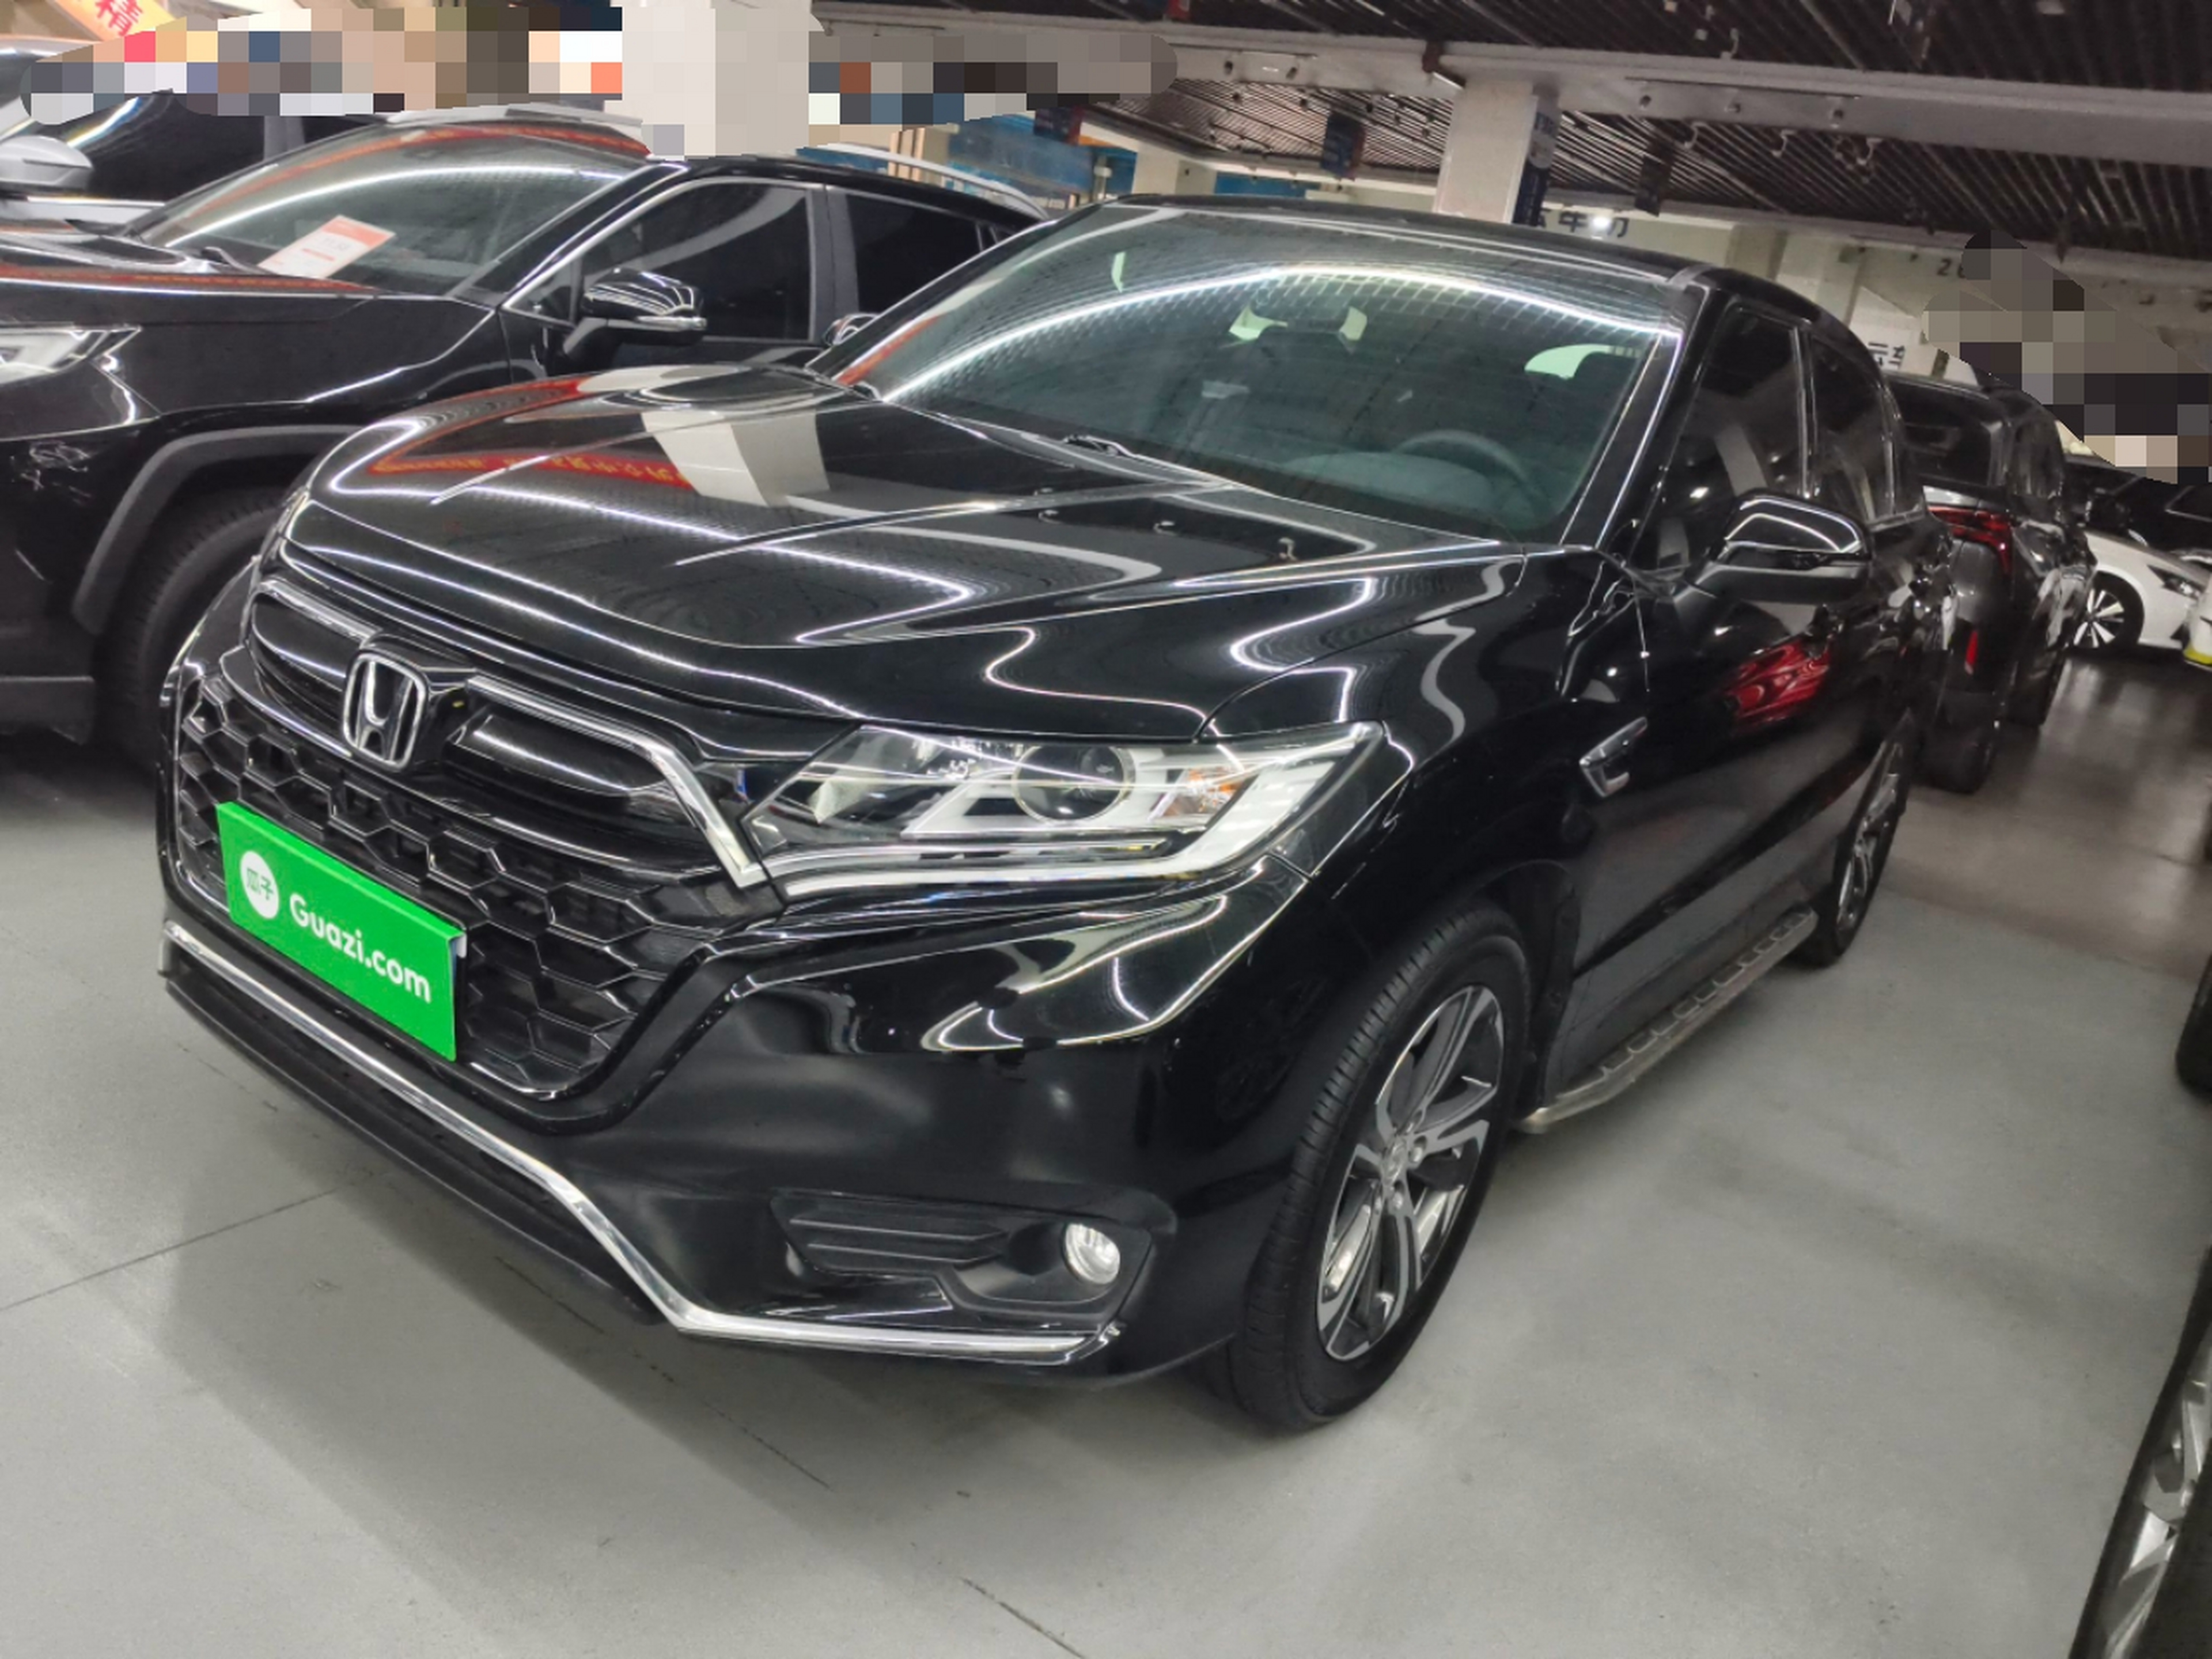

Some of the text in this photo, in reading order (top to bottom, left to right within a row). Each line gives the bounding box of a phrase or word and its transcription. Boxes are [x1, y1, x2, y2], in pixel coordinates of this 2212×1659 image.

[95, 0, 143, 36] 精
[247, 866, 274, 900] 瓜子
[289, 893, 432, 1003] Guazi.com
